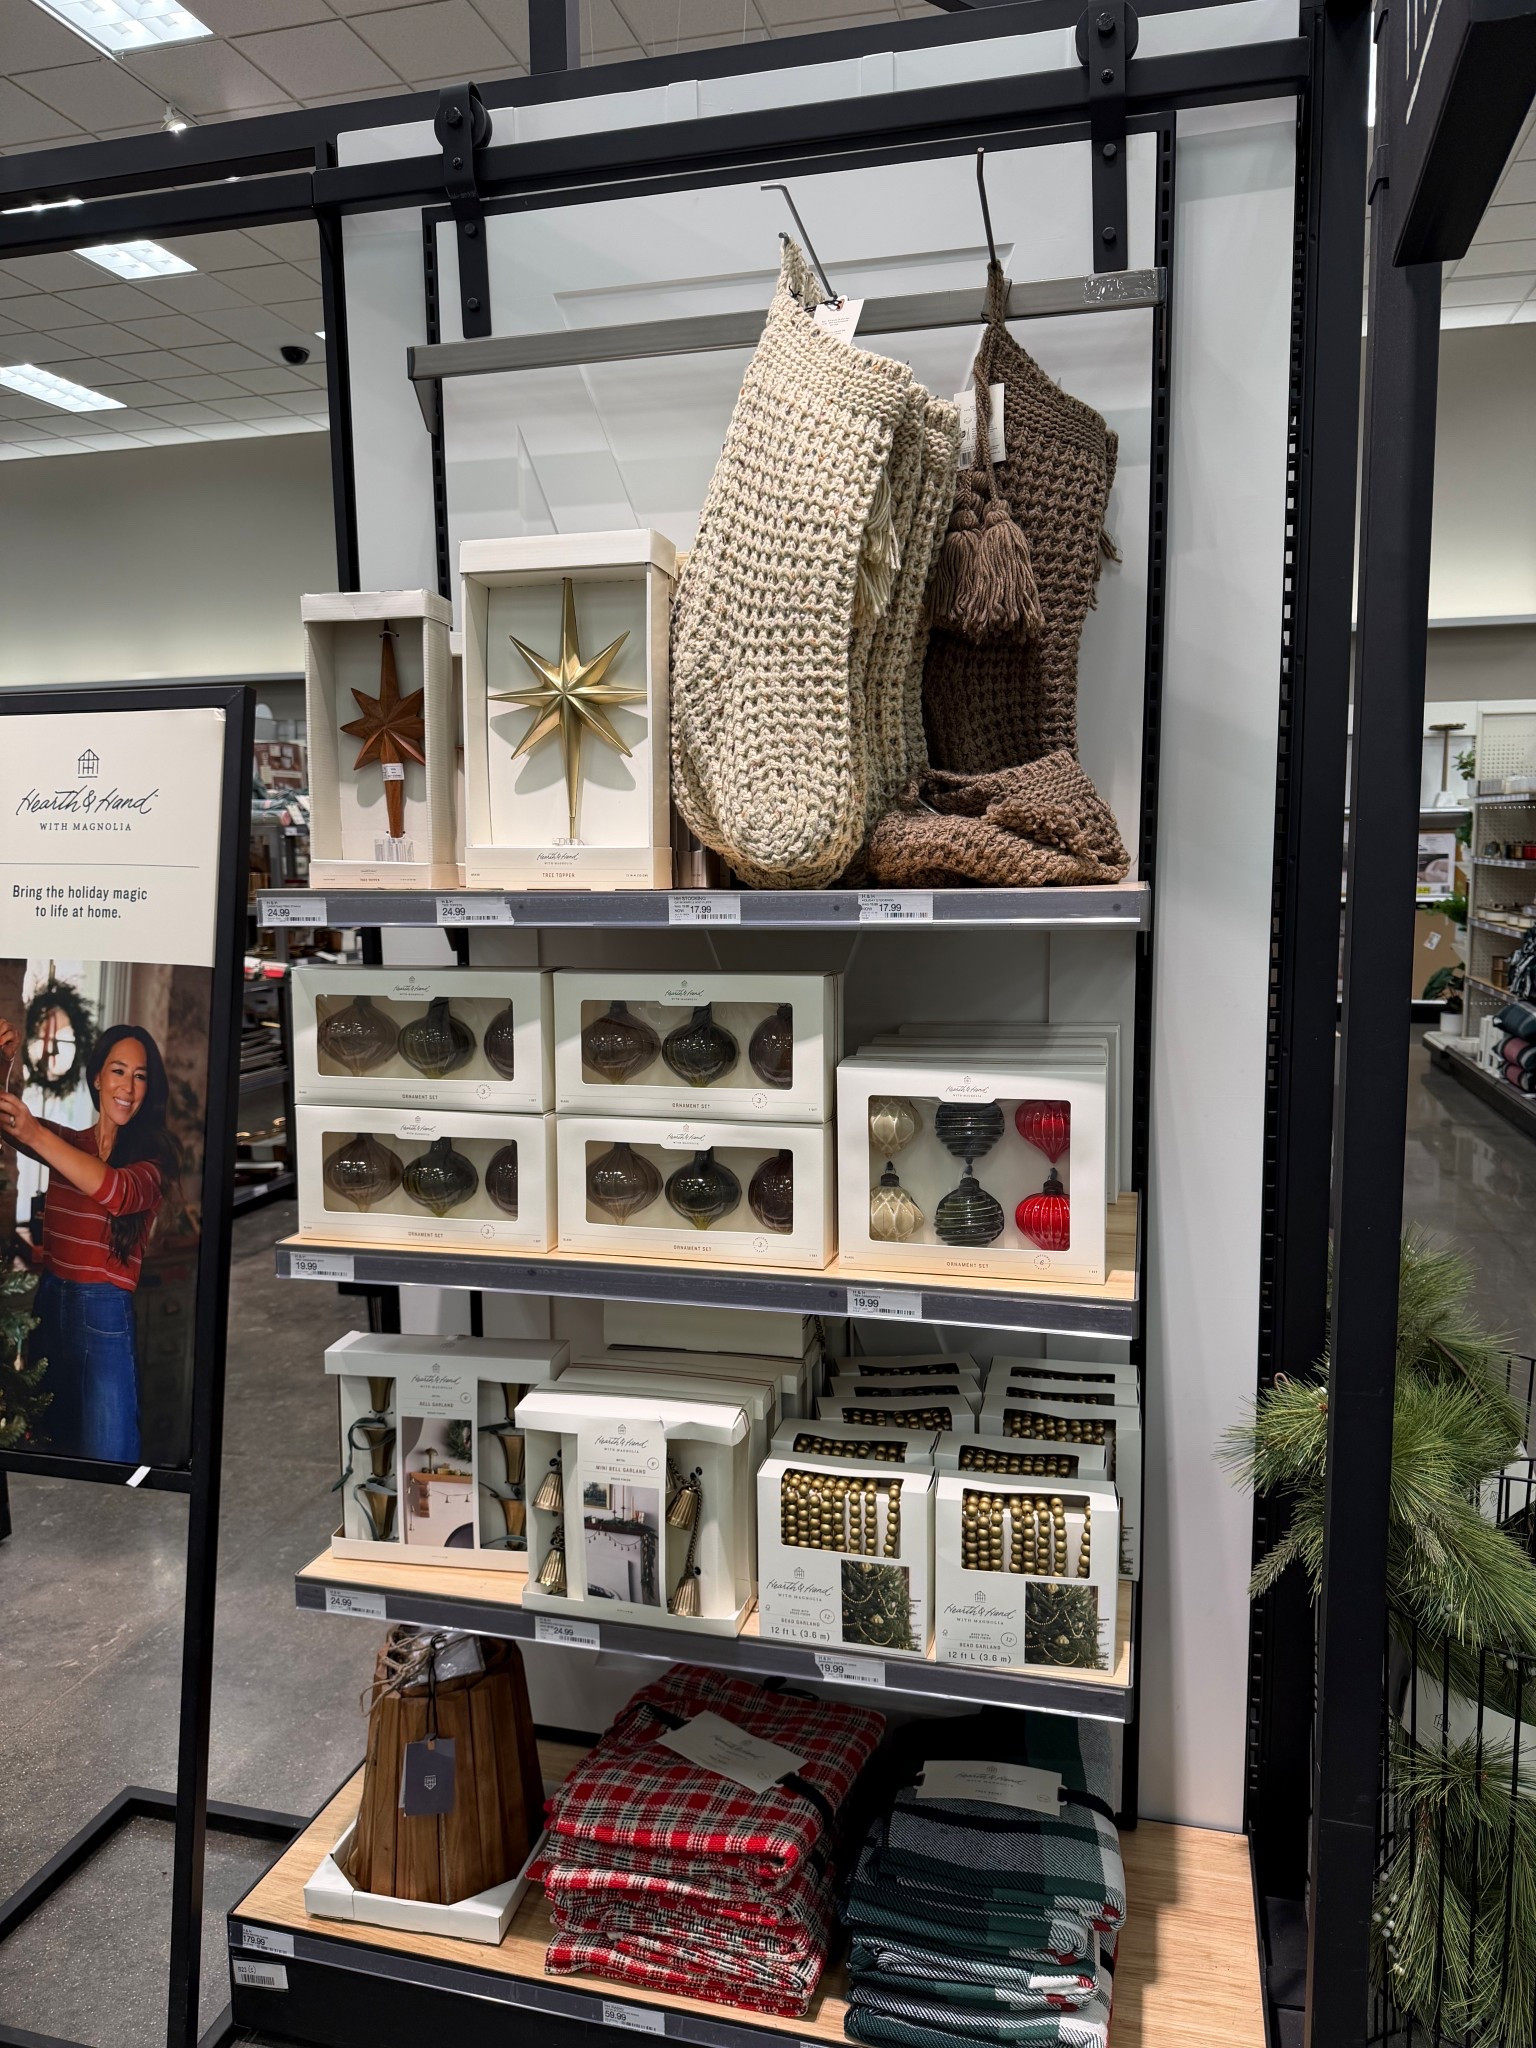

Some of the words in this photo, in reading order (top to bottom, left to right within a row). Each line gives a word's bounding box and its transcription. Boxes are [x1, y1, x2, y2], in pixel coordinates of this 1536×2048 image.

[16, 785, 88, 815] Hearth
[82, 789, 97, 813] &
[94, 787, 159, 814] Hand
[40, 822, 68, 831] WITH
[73, 823, 132, 832] MAGNOLIA
[12, 884, 43, 901] Bring
[46, 885, 65, 899] the
[68, 886, 110, 902] holiday
[113, 887, 148, 902] magic
[35, 905, 47, 918] to
[50, 904, 69, 918] life
[72, 906, 84, 918] at
[87, 905, 121, 919] home.
[267, 908, 290, 917] 24.99
[442, 907, 466, 916] 24.99
[690, 906, 712, 914] 17.99
[879, 903, 902, 912] 17.99
[296, 1262, 318, 1270] 19.99
[854, 1298, 879, 1307] 19.99
[766, 1579, 800, 1592] Hearth
[804, 1584, 834, 1596] Hand
[331, 1596, 352, 1607] 24.99
[944, 1603, 980, 1616] Hearth
[985, 1607, 1016, 1620] Hand
[796, 1619, 820, 1627] GARLAND
[554, 1626, 574, 1636] 24.99
[771, 1626, 780, 1634] 12
[800, 1629, 817, 1639] (3.6
[820, 1632, 830, 1641] m)
[980, 1653, 997, 1662] (3.6
[1000, 1655, 1011, 1664] m)
[820, 1663, 844, 1674] 19.99
[243, 1935, 265, 1946] 179.99
[605, 2010, 627, 2021] 59.99
